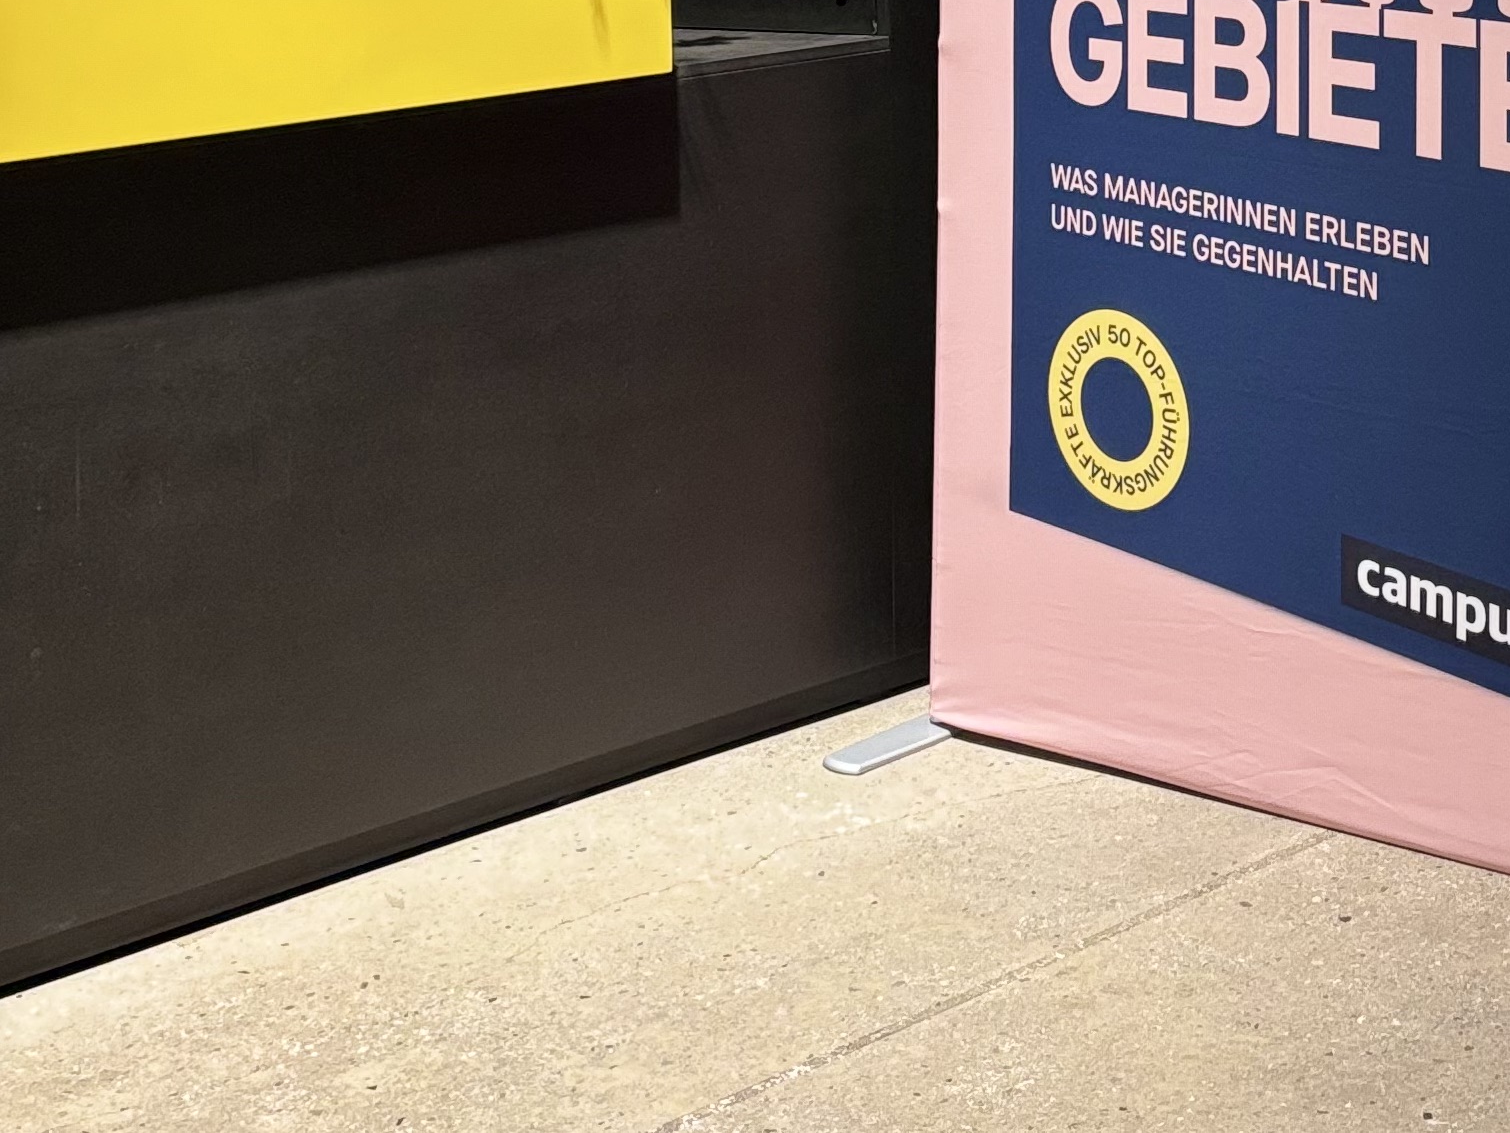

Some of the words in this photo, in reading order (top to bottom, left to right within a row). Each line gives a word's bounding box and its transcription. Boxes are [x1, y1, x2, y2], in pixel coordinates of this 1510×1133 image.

[1051, 163, 1098, 196] WAS
[1104, 173, 1296, 236] MANAGERINNEN
[1305, 212, 1430, 265] ERLEBEN
[1051, 204, 1097, 236] UND
[1102, 214, 1144, 247] WIE
[1149, 224, 1187, 257] SIE
[1193, 233, 1378, 301] GEGENHALTEN
[1058, 325, 1101, 418] EXKLUSIV
[1108, 324, 1131, 348] 50
